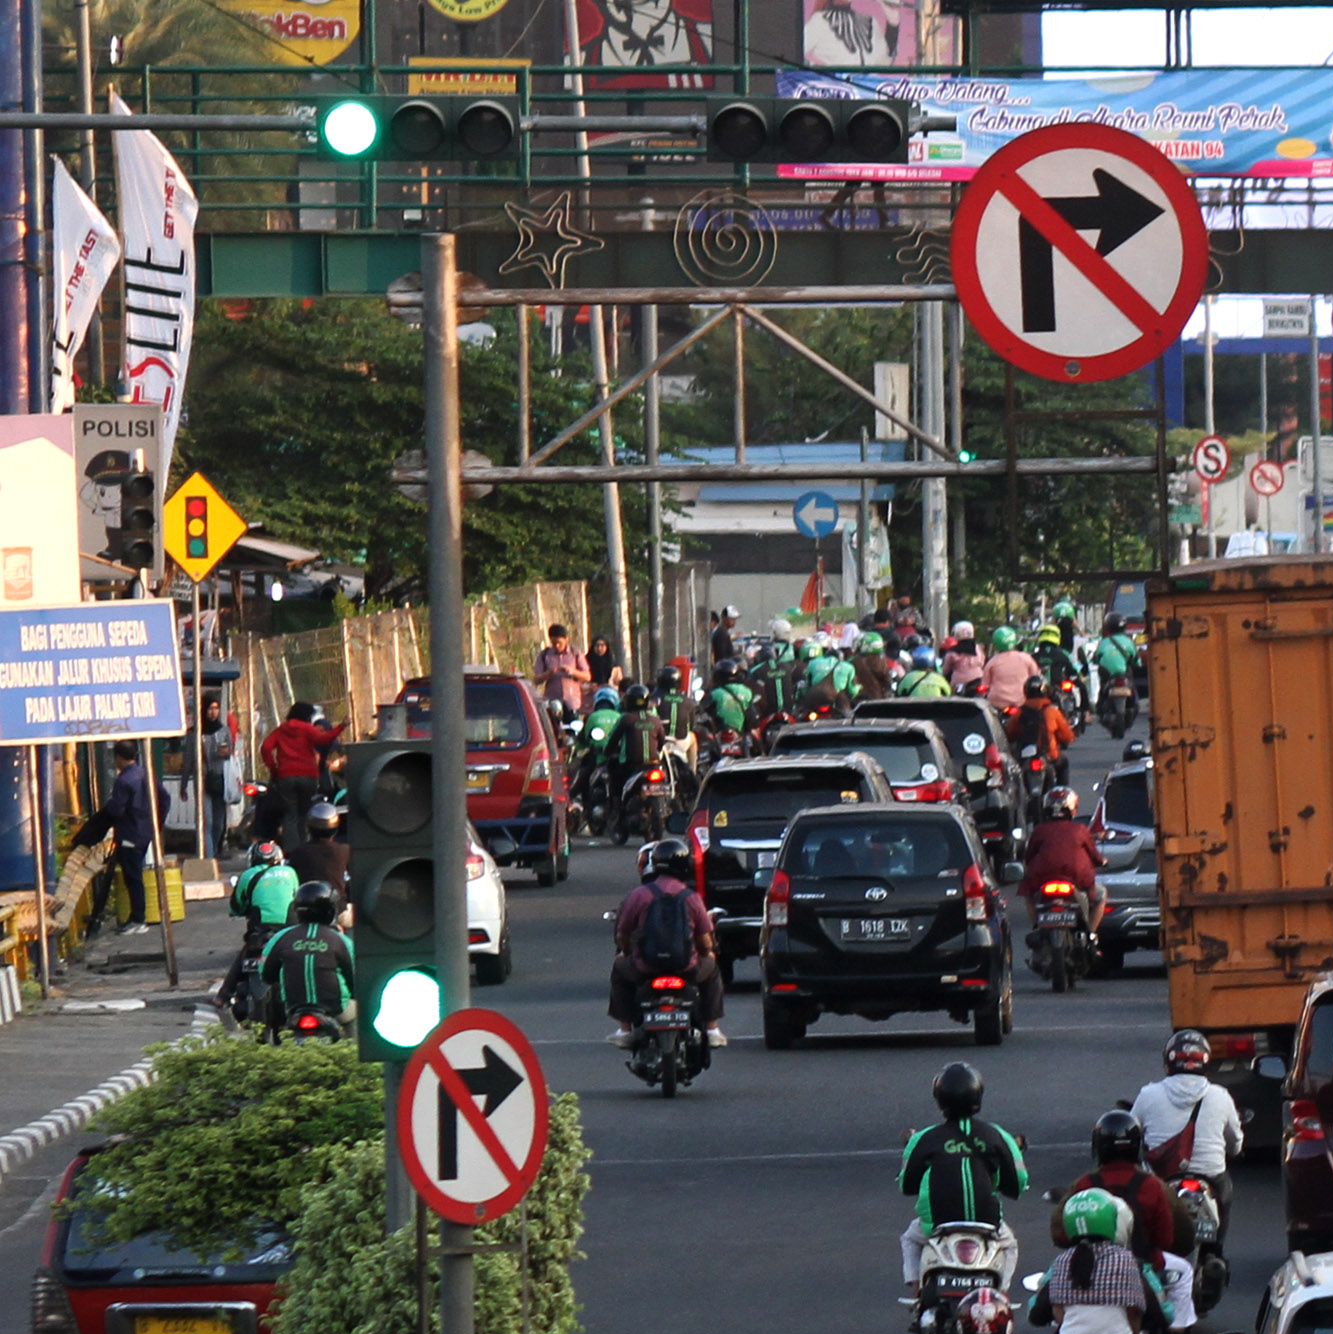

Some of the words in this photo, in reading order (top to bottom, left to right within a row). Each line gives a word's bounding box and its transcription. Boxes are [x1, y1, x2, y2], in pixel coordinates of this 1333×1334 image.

[968, 104, 1043, 131] Gabung
[1050, 104, 1072, 127] di
[1152, 102, 1215, 132] Reuni
[1218, 102, 1289, 134] Perak
[1154, 139, 1202, 160] KATAN
[1204, 139, 1225, 160] 94
[82, 419, 155, 438] POLISI
[20, 624, 49, 652] BAGI
[50, 621, 107, 651] PENGGUNA
[107, 619, 149, 647] SEPEDA
[0, 660, 54, 689] GUNAKAN
[57, 657, 91, 687] JALUR
[91, 655, 134, 684] KHUSUS
[134, 654, 175, 682] SEPEDA
[25, 696, 56, 723] PADA
[57, 694, 94, 722] LAJUR
[94, 691, 132, 720] PALING
[132, 690, 157, 718] KIRI
[841, 919, 850, 933] B
[292, 939, 329, 952] Grab
